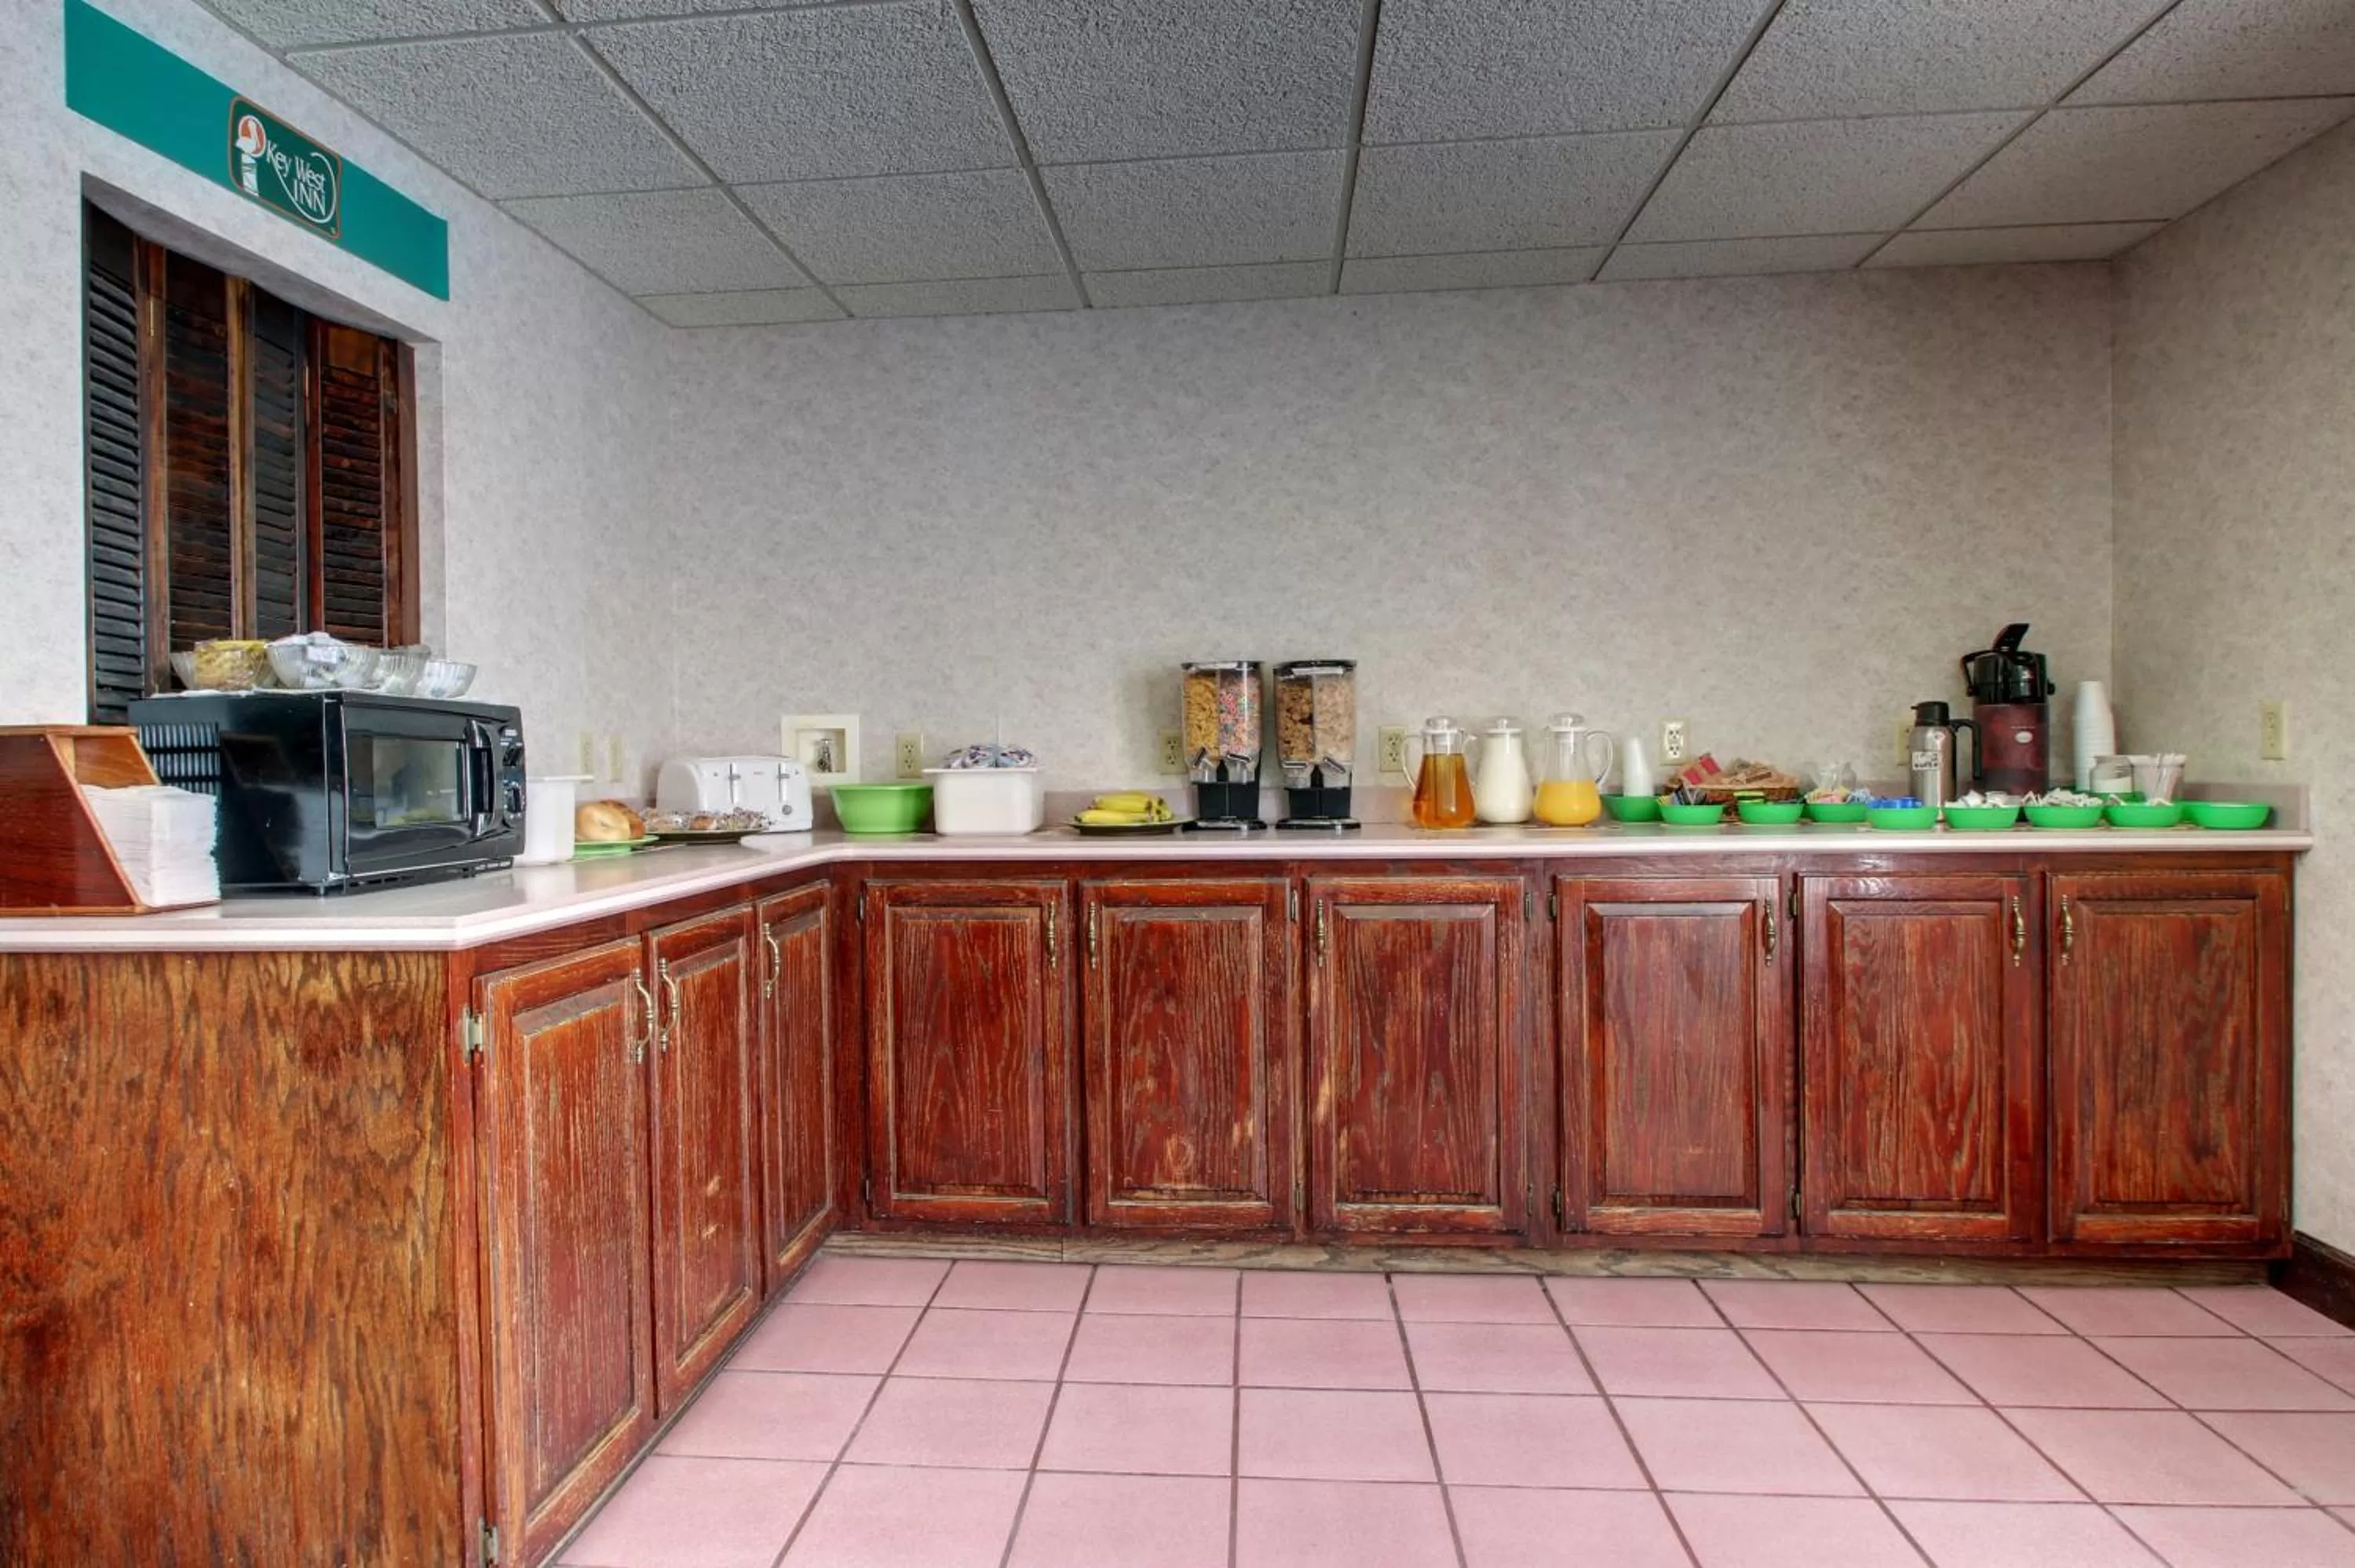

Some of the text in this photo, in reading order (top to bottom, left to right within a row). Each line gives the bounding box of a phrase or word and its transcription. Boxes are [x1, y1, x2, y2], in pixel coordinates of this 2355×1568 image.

[266, 140, 326, 195] Key West
[293, 179, 326, 216] INN
